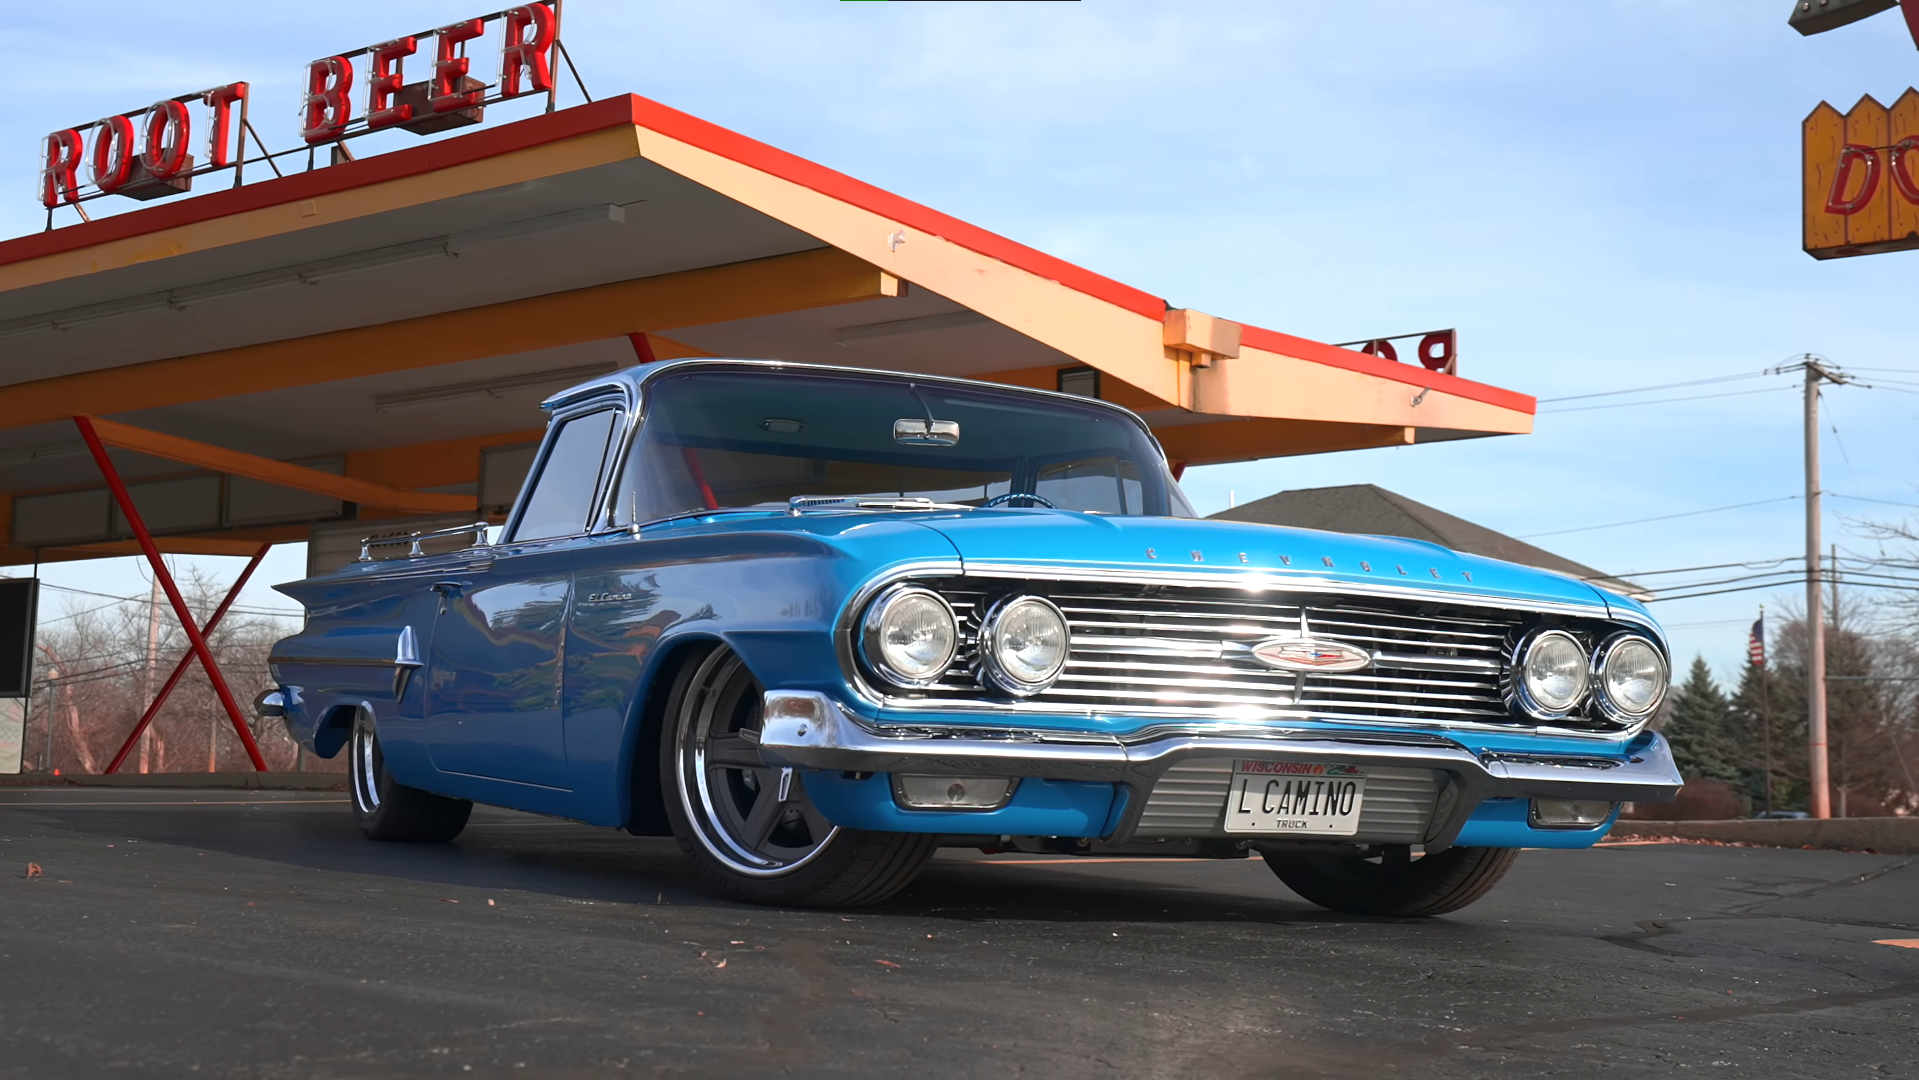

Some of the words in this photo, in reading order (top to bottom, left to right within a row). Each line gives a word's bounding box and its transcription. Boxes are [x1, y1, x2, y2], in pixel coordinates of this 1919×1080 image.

[37, 81, 247, 207] ROOT
[299, 2, 556, 143] BEER
[1145, 548, 1472, 582] CHEVROLET
[600, 592, 634, 601] Camino
[1241, 760, 1313, 774] WISCONSIN
[1238, 779, 1252, 814] L
[1262, 779, 1356, 816] CAMINO
[1276, 819, 1309, 829] TRUCK
